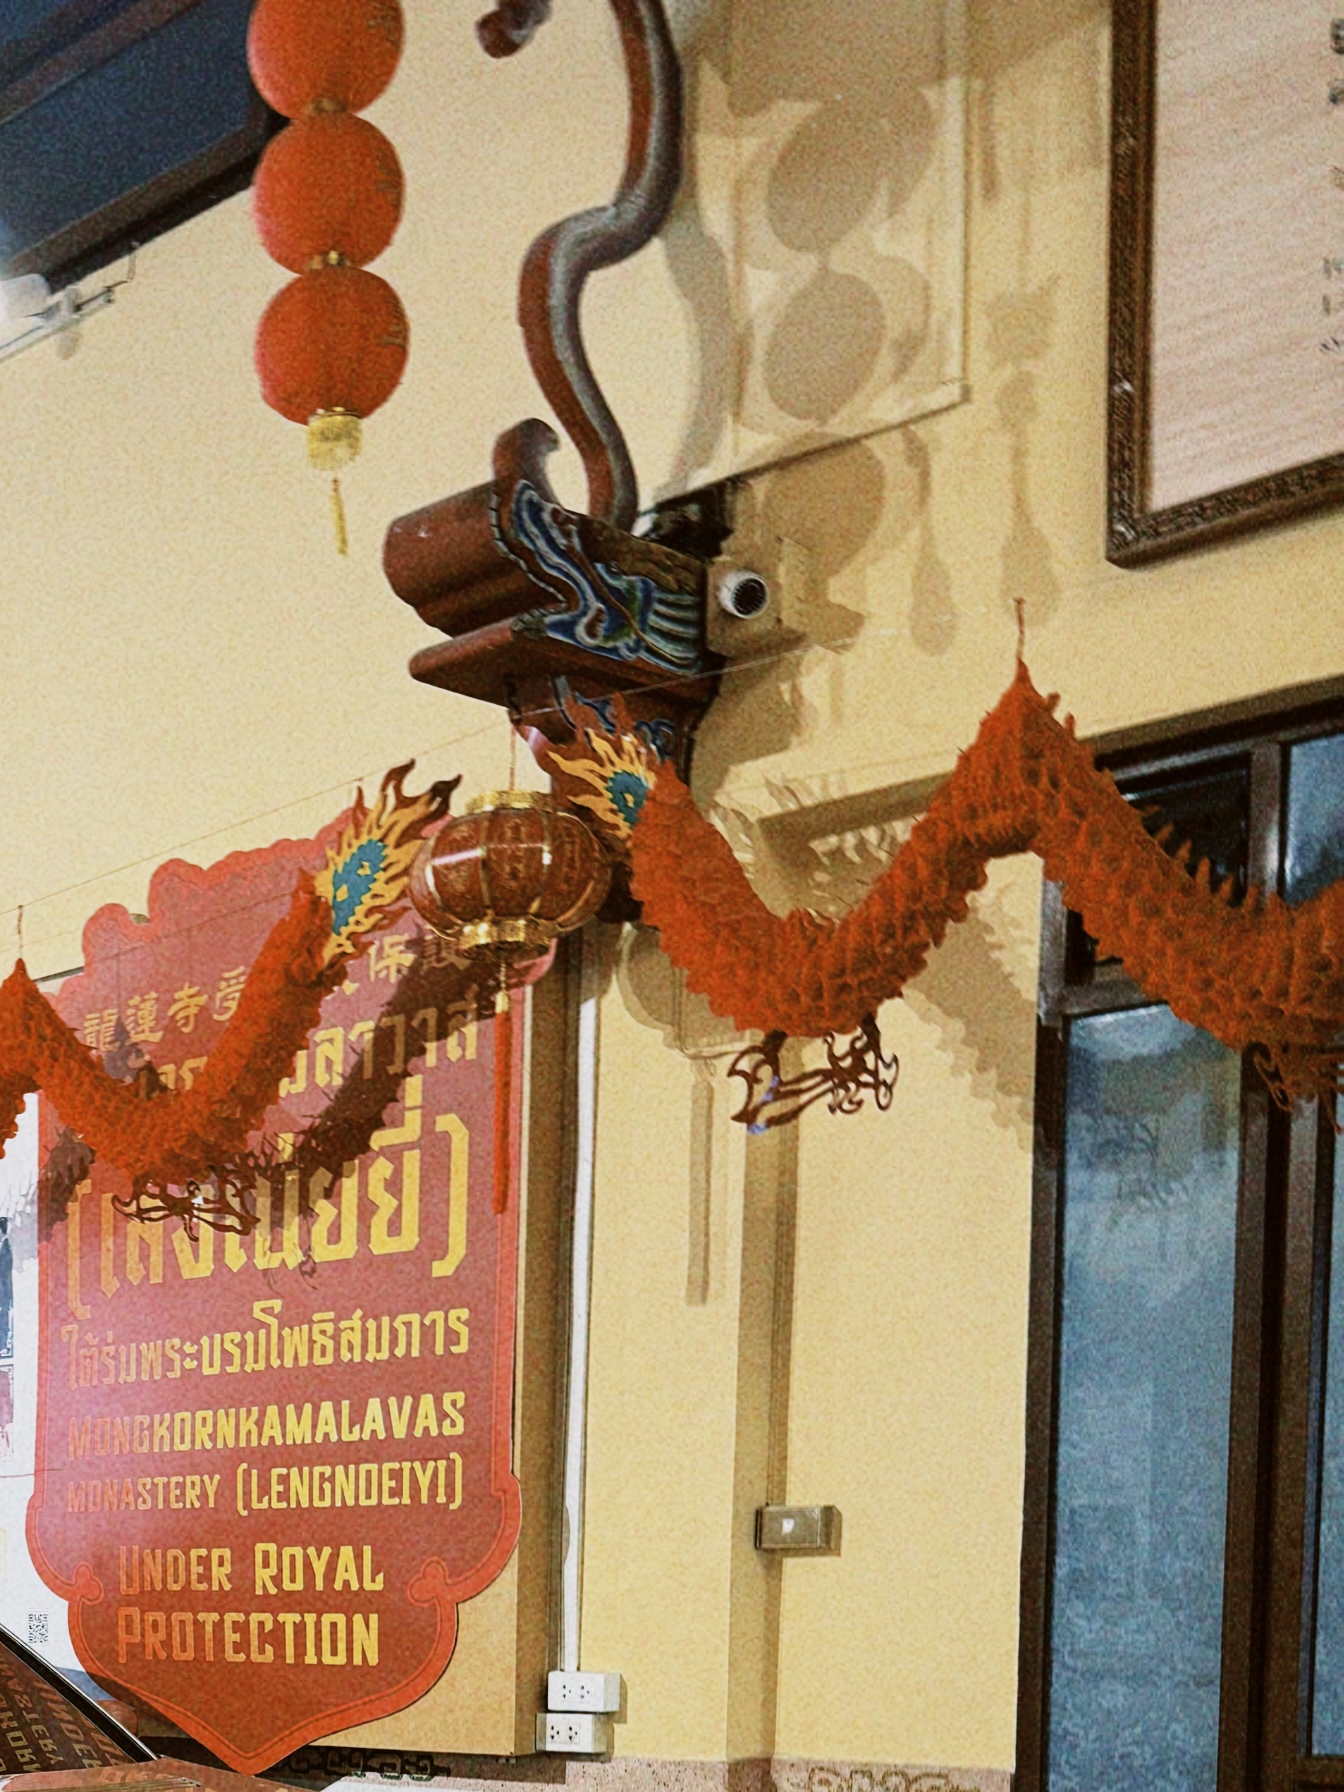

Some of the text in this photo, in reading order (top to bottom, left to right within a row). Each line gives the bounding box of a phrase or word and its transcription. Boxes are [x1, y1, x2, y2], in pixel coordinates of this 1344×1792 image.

[61, 1299, 470, 1391] ใต้ร่มพระบรมโพธิสมภาร
[117, 1541, 385, 1596] UNDER ROYAL
[117, 1605, 381, 1667] PROTECTION
